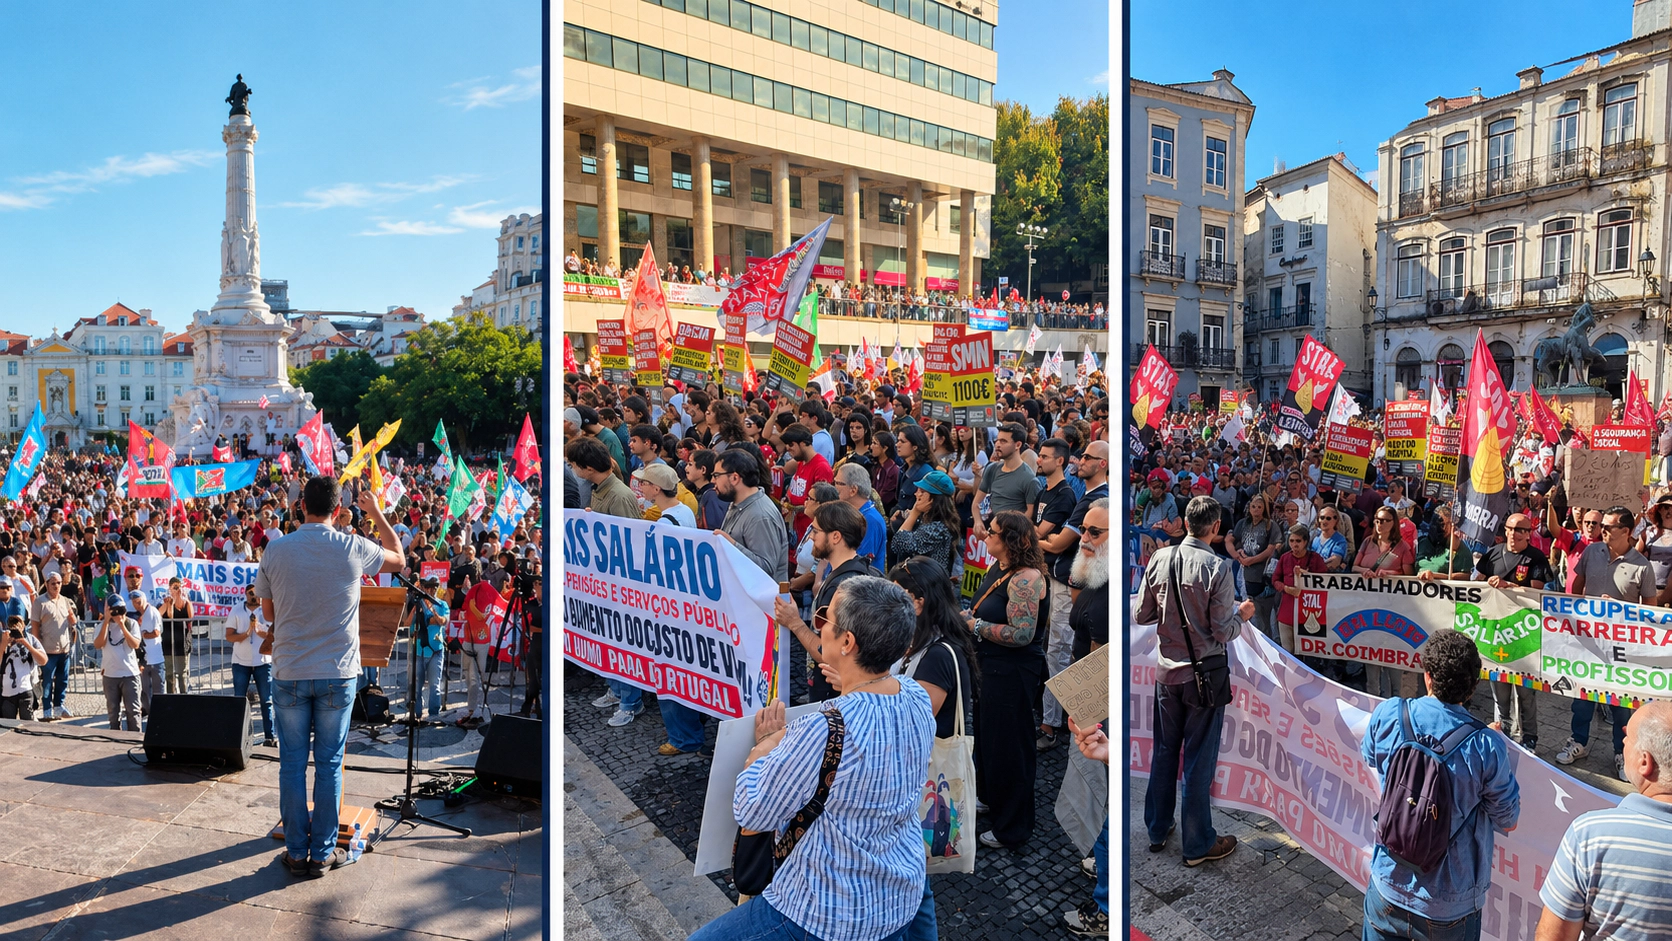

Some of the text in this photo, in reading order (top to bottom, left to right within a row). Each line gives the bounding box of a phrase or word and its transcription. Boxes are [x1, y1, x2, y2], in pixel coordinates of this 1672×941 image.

[951, 339, 990, 372] SMN
[952, 378, 990, 402] 1100€
[175, 561, 227, 584] MAIS
[593, 521, 723, 602] SALÁRIO
[611, 583, 618, 603] E
[1301, 573, 1482, 604] TRABALHADORES
[1302, 592, 1322, 608] STAL
[696, 633, 720, 674] DE
[1612, 645, 1627, 663] E
[1542, 655, 1672, 690] PROFISSÕ
